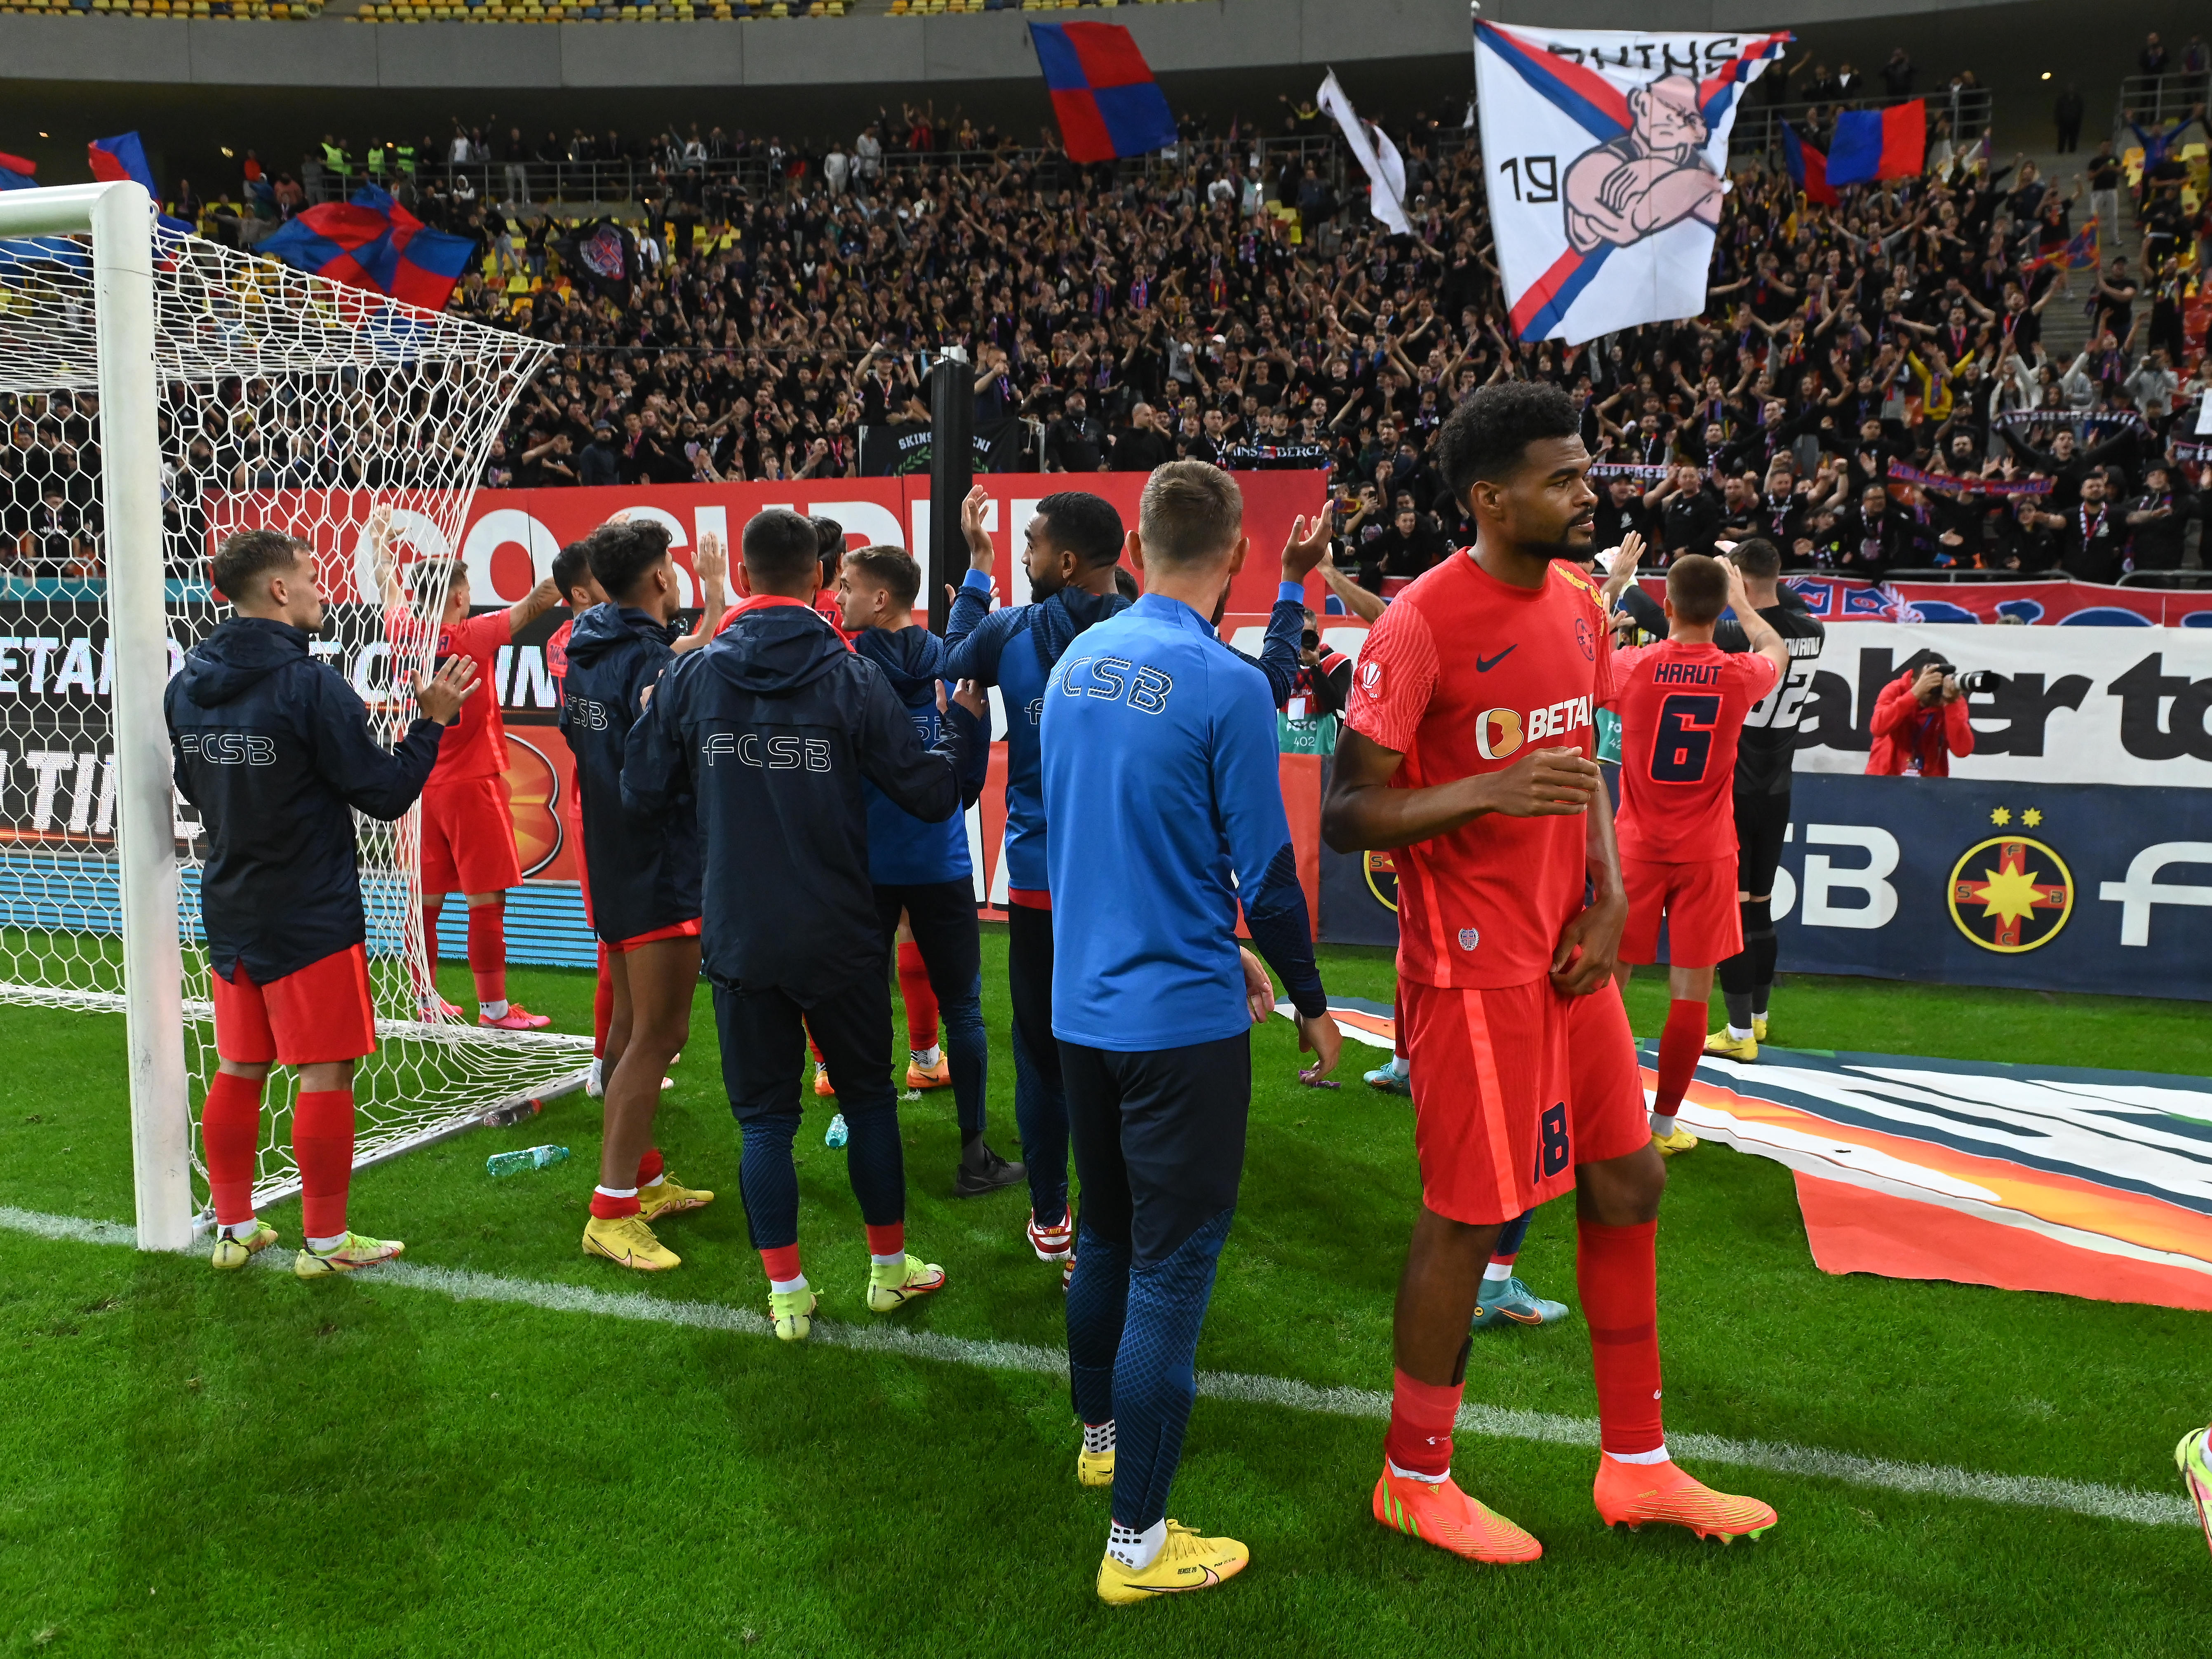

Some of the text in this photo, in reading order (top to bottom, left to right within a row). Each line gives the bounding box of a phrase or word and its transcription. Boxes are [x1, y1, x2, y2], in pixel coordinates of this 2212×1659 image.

[1500, 155, 1558, 203] 19
[1654, 663, 1722, 685] HARUT
[1294, 736, 1315, 747] 402
[1651, 693, 1723, 783] 6
[1534, 1101, 1569, 1186] 8
